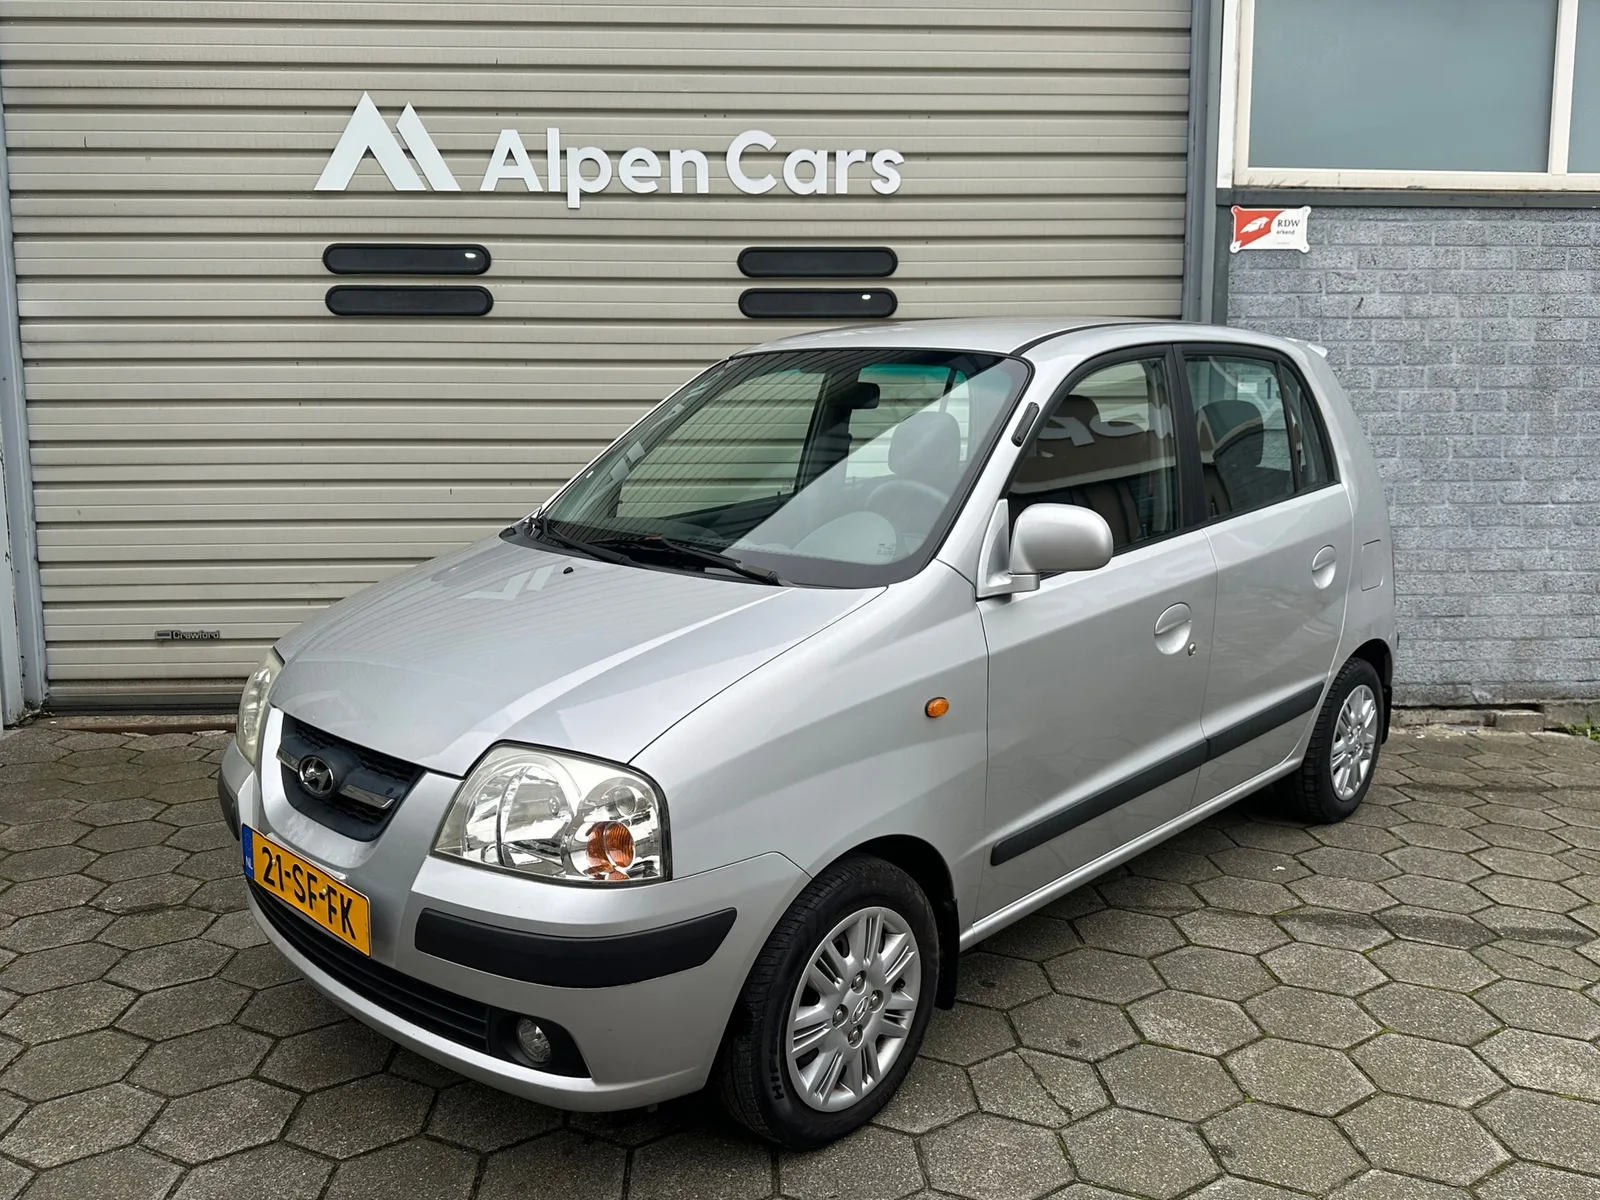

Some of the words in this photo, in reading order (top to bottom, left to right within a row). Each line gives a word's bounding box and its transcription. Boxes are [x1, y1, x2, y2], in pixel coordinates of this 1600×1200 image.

[479, 127, 709, 209] Alpen
[726, 129, 904, 196] Cars
[1277, 219, 1301, 228] RDW
[172, 630, 220, 639] Crawford
[245, 855, 253, 869] NL
[262, 846, 356, 940] 21-SF-FK
